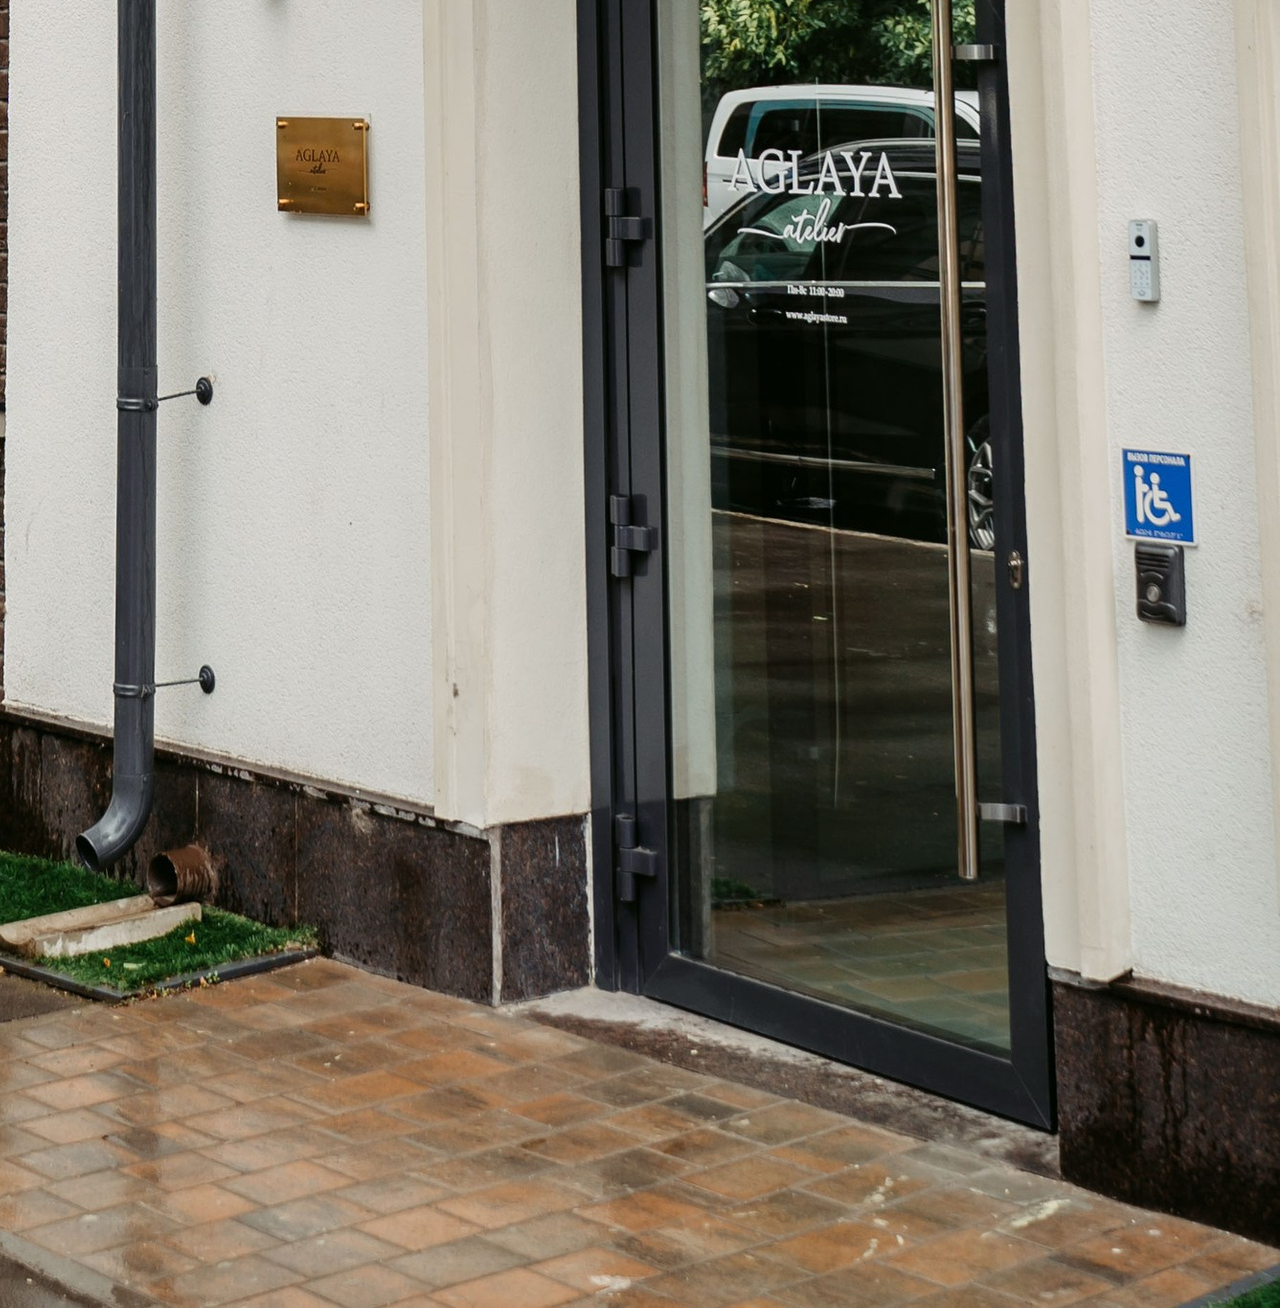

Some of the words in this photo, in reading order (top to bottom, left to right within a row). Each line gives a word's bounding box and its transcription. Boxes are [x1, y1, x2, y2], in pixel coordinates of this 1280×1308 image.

[296, 148, 340, 162] AGLAYA
[728, 147, 903, 199] AGLAYA
[1127, 451, 1148, 463] ВЫЗОВ
[1149, 454, 1186, 467] ПЕРСОНАЛА
